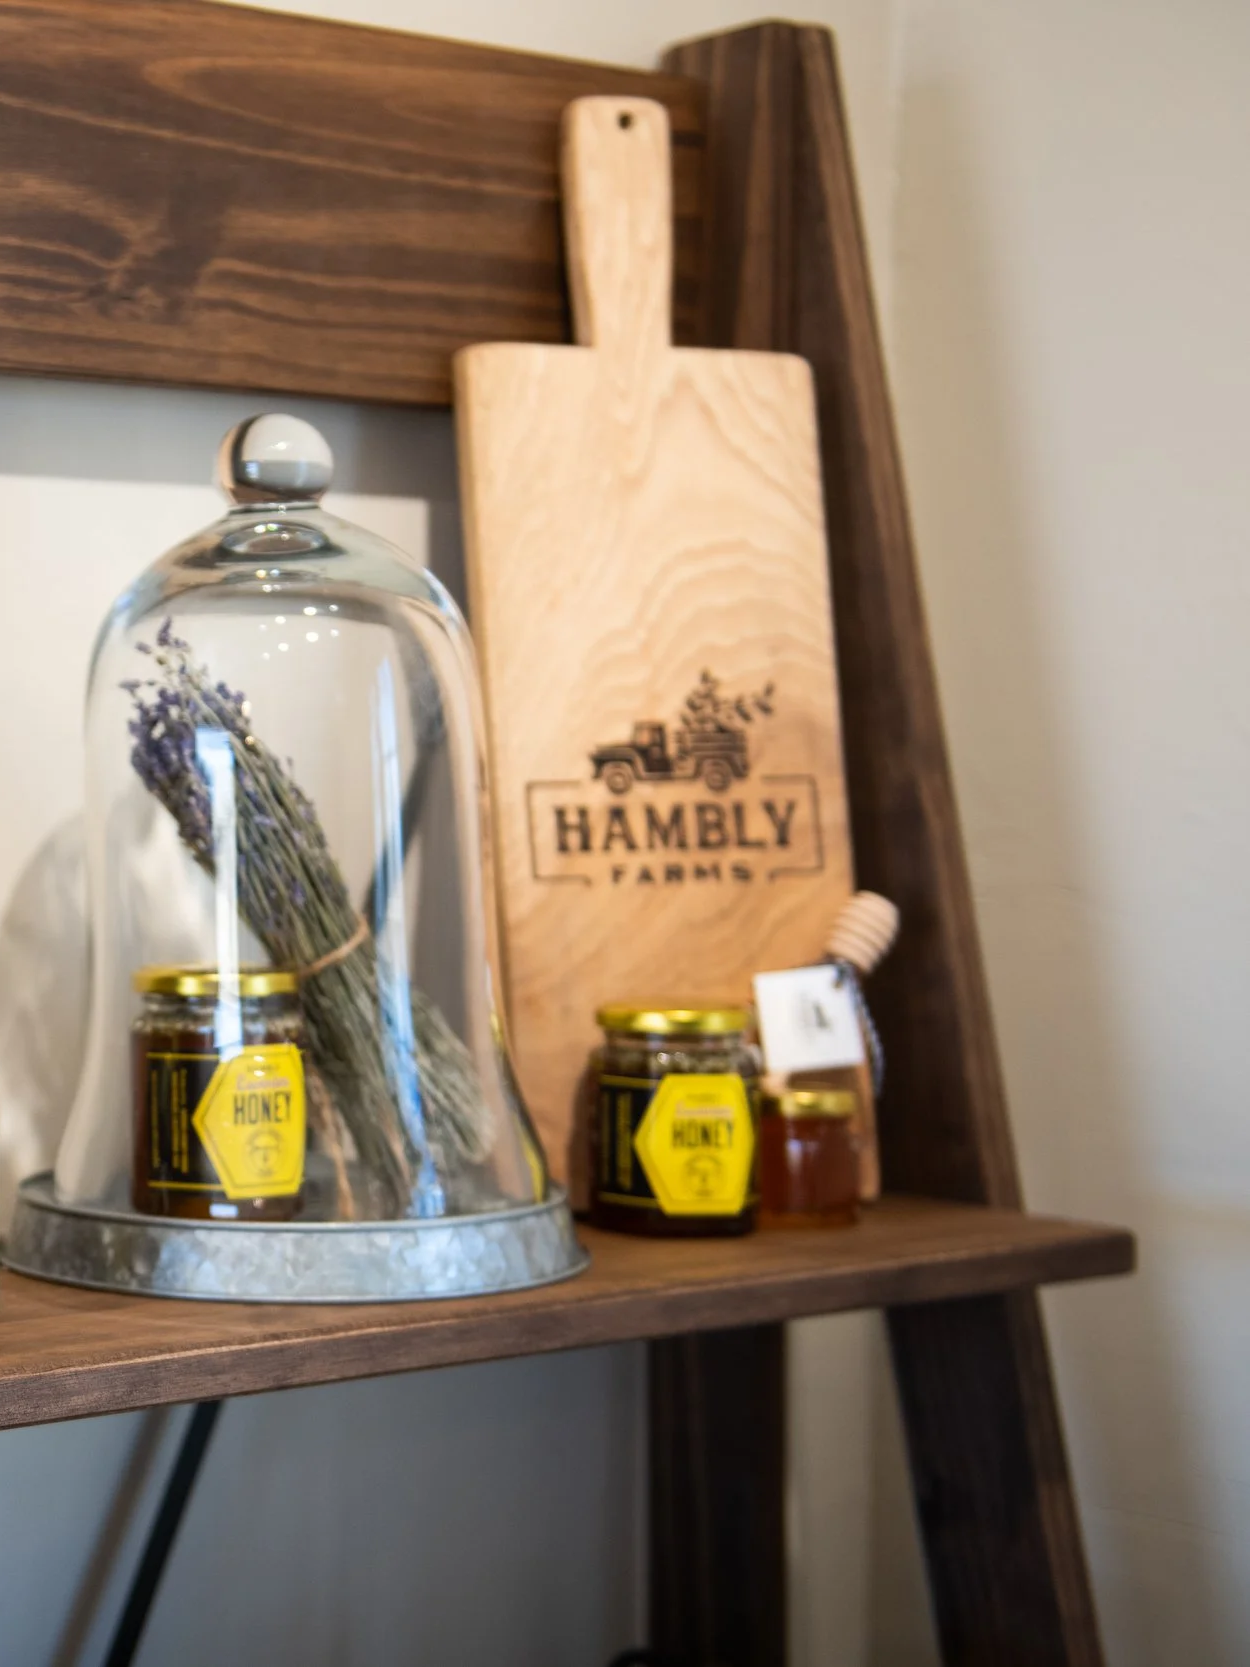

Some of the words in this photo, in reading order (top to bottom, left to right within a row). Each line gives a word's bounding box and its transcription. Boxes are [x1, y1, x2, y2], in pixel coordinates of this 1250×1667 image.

[554, 800, 796, 853] HAMBLY
[612, 861, 753, 885] FARMS
[233, 1091, 292, 1126] HONEY
[672, 1118, 734, 1149] HONEY
